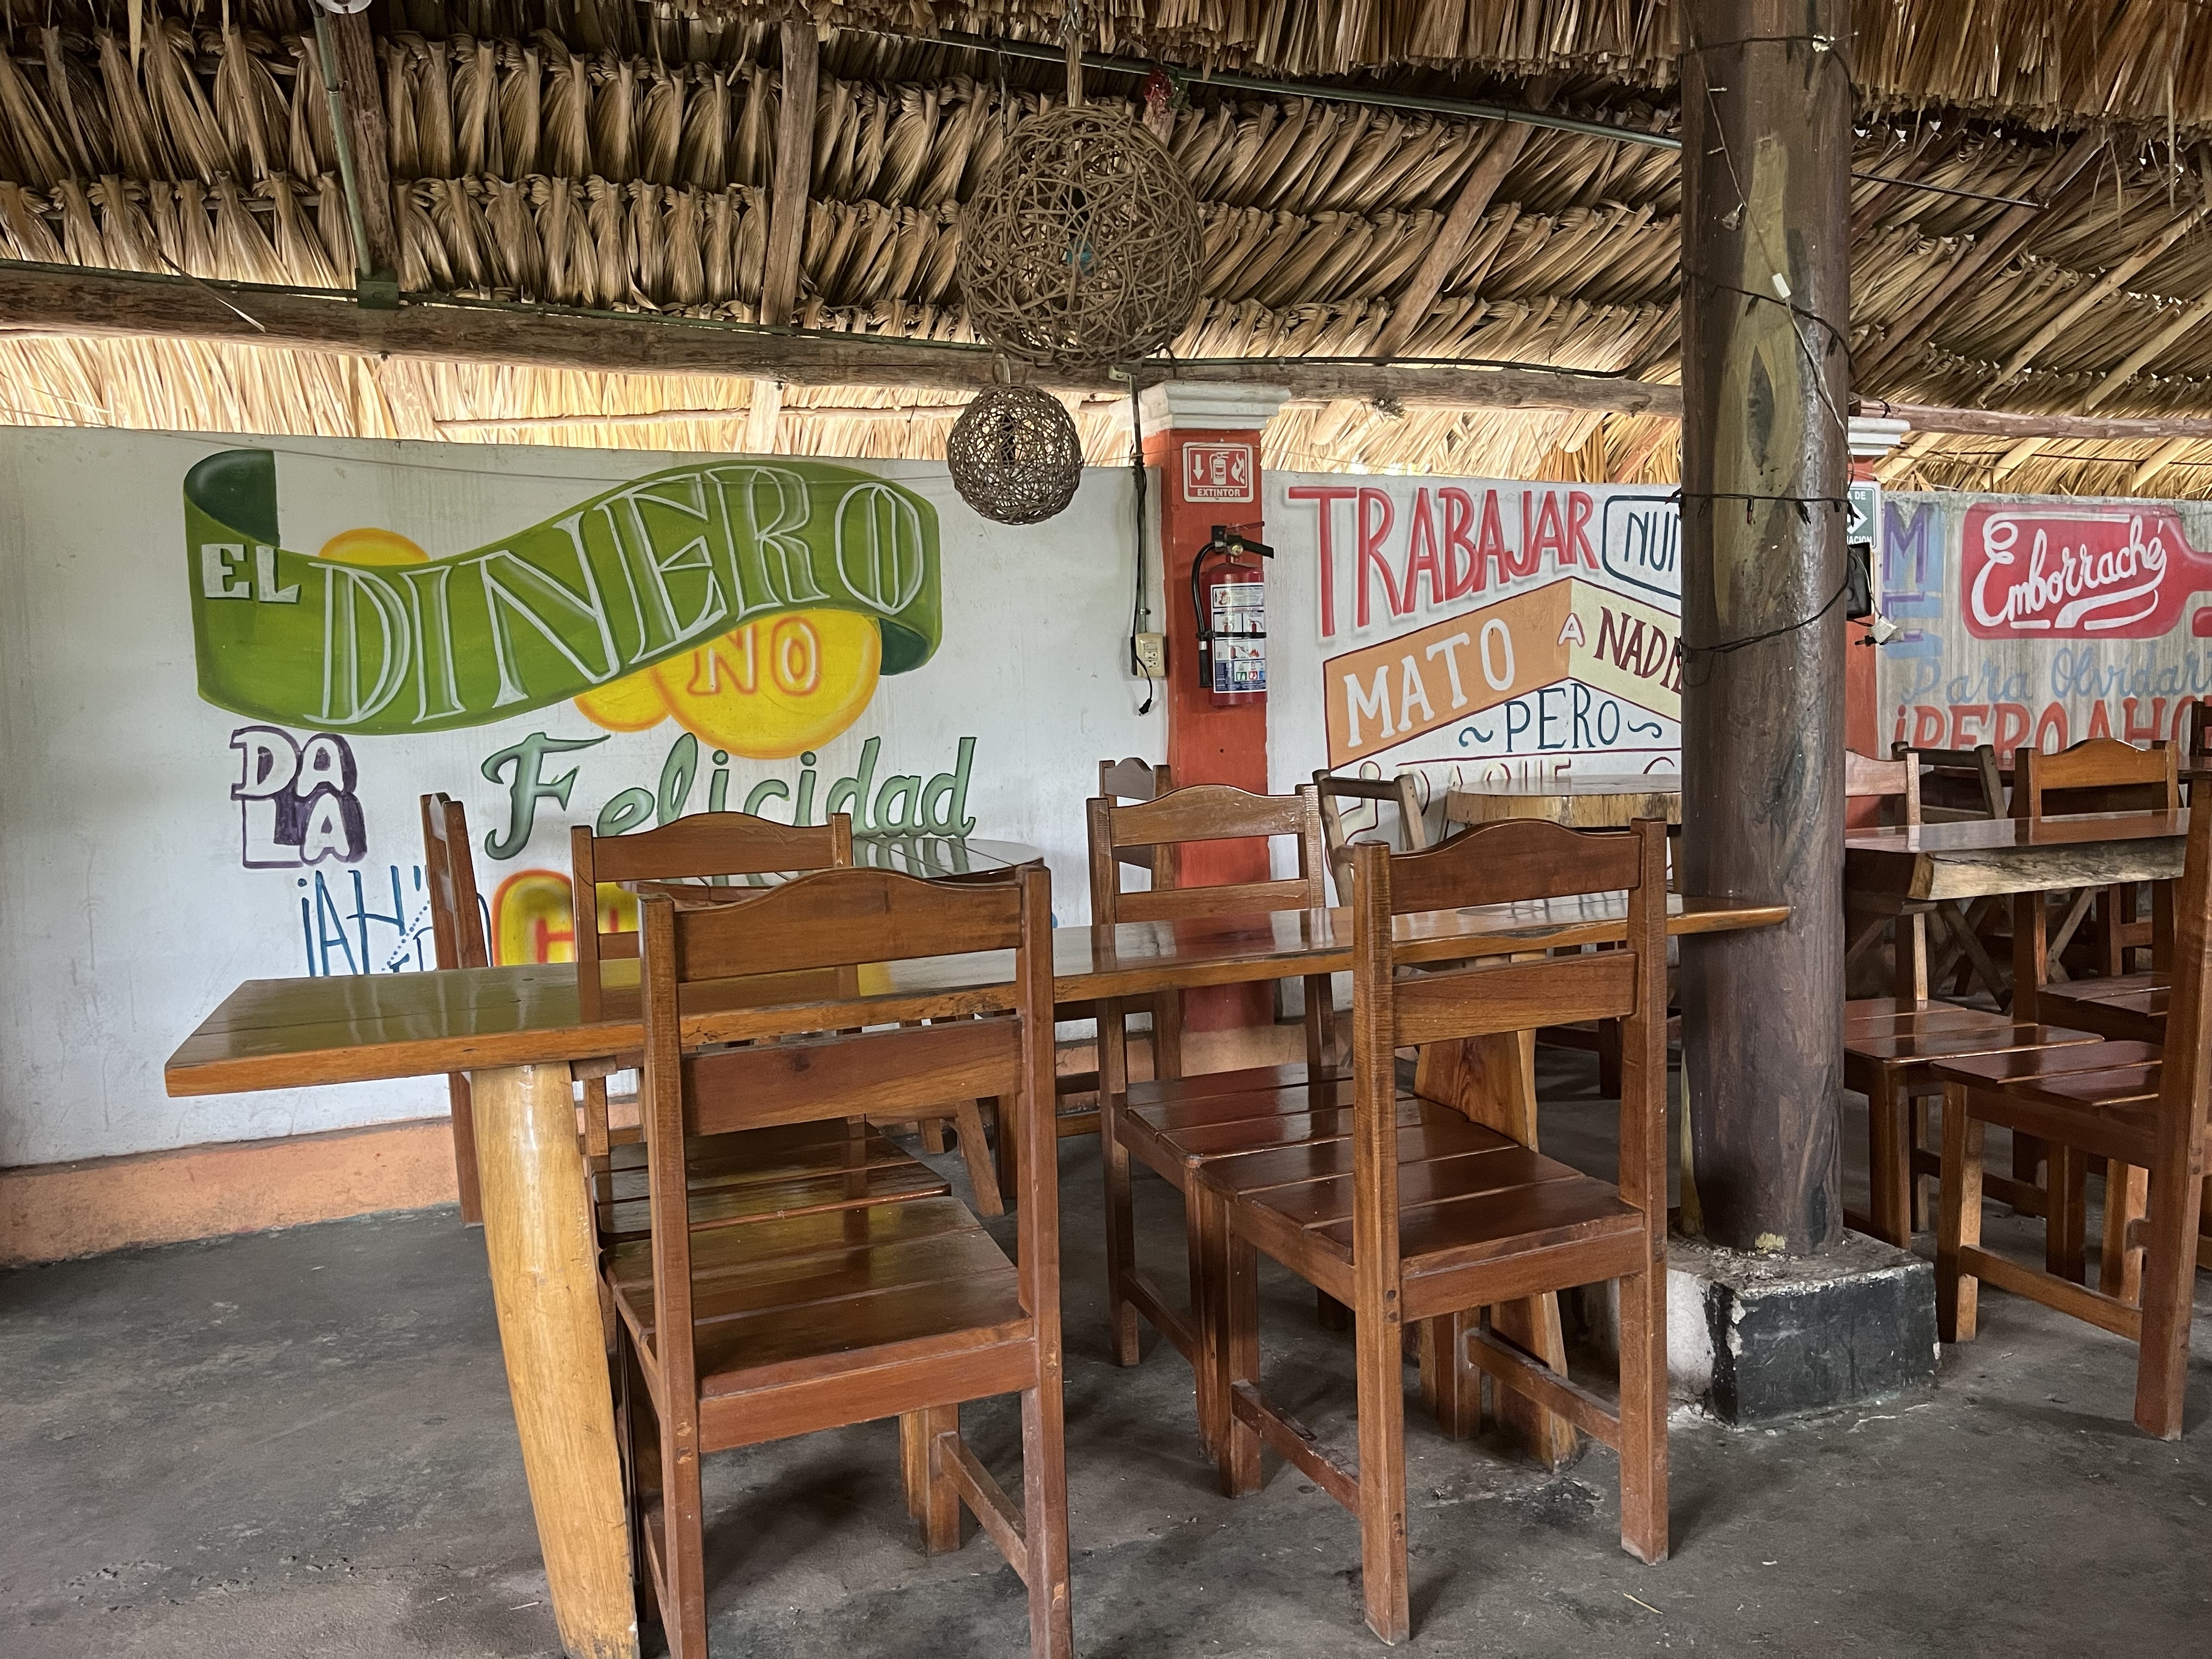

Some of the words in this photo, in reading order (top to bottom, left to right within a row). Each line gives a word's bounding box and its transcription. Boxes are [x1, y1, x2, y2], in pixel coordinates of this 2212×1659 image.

[1197, 488, 1240, 497] EXTINTOR
[1854, 490, 1866, 500] DE
[1288, 486, 1600, 637] TRABAJAR
[1624, 511, 1682, 572] NU
[1847, 535, 1872, 545] ACION
[1971, 511, 2168, 627] Emborraché
[201, 543, 301, 603] EL
[303, 466, 924, 724] DINERO
[687, 614, 822, 696] NO
[1343, 618, 1515, 748] MATO
[1557, 612, 1586, 648] A
[1900, 657, 2032, 705] Para
[2051, 640, 2212, 698] Olvidar
[1504, 683, 1620, 753] PERO
[230, 725, 358, 800] DA
[481, 731, 977, 860] Felicidad
[242, 792, 368, 868] LA
